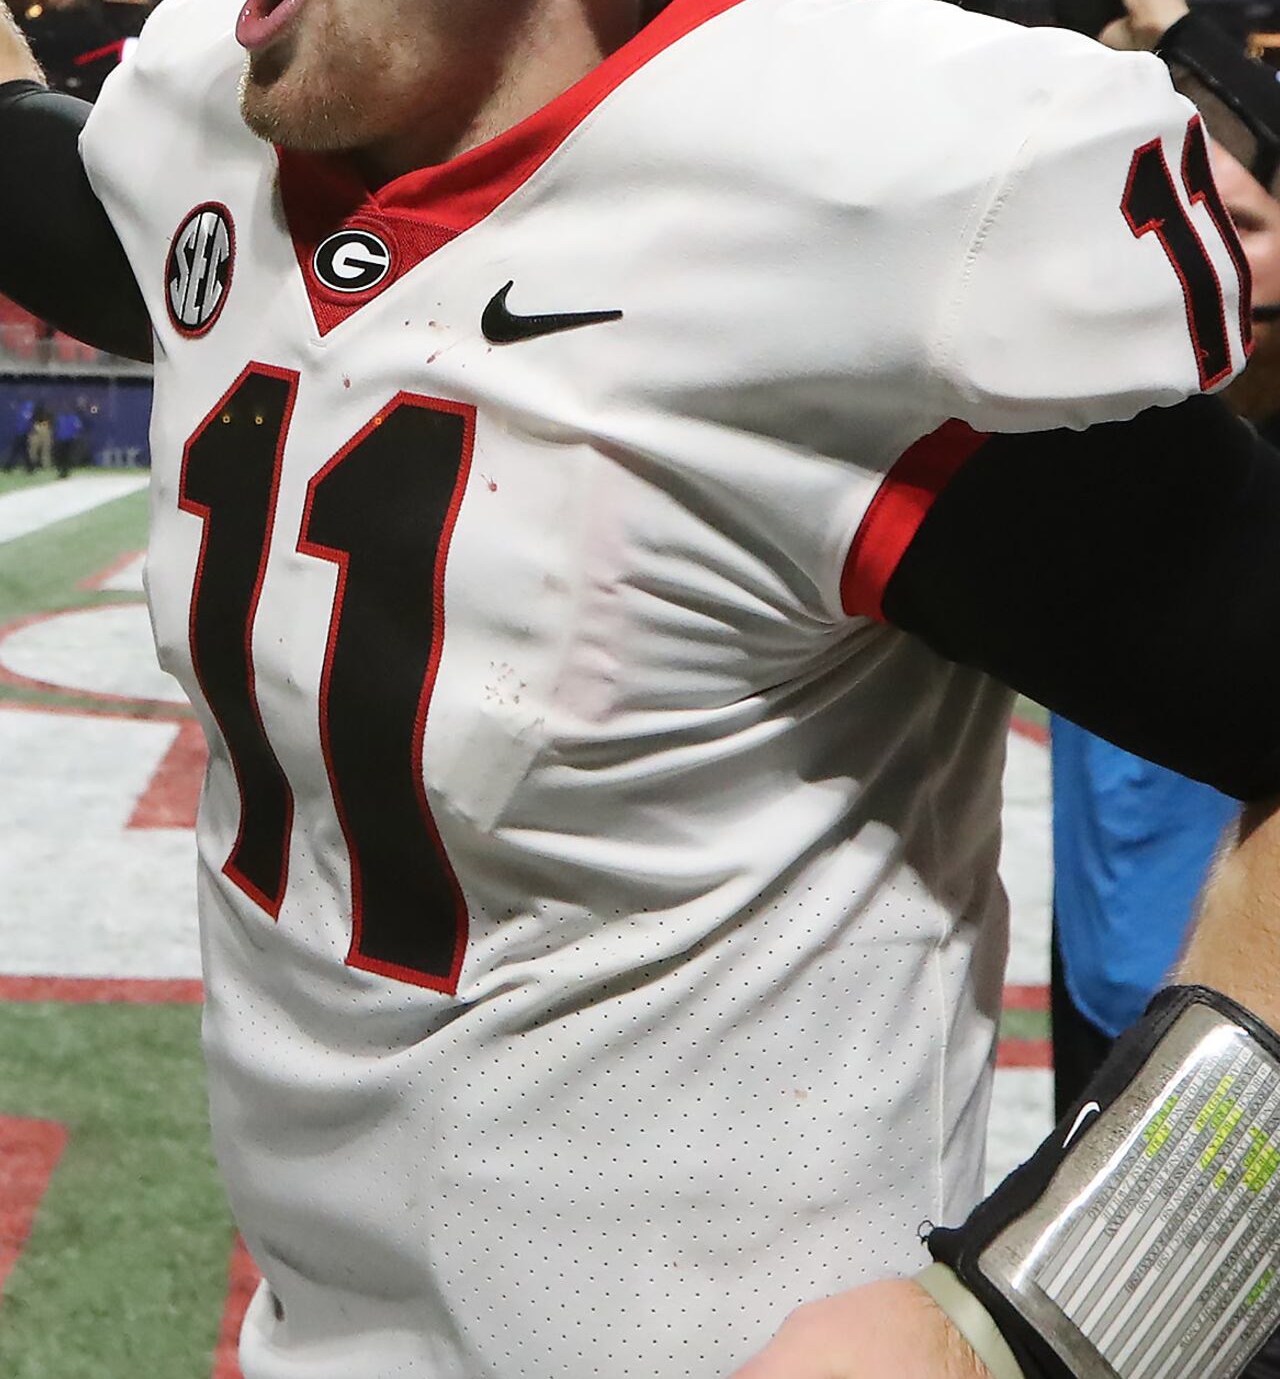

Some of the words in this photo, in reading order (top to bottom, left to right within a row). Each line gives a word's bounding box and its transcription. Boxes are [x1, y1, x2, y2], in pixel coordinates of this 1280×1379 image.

[169, 212, 230, 325] SEC
[1120, 112, 1256, 391] 11
[179, 360, 476, 996] 11
